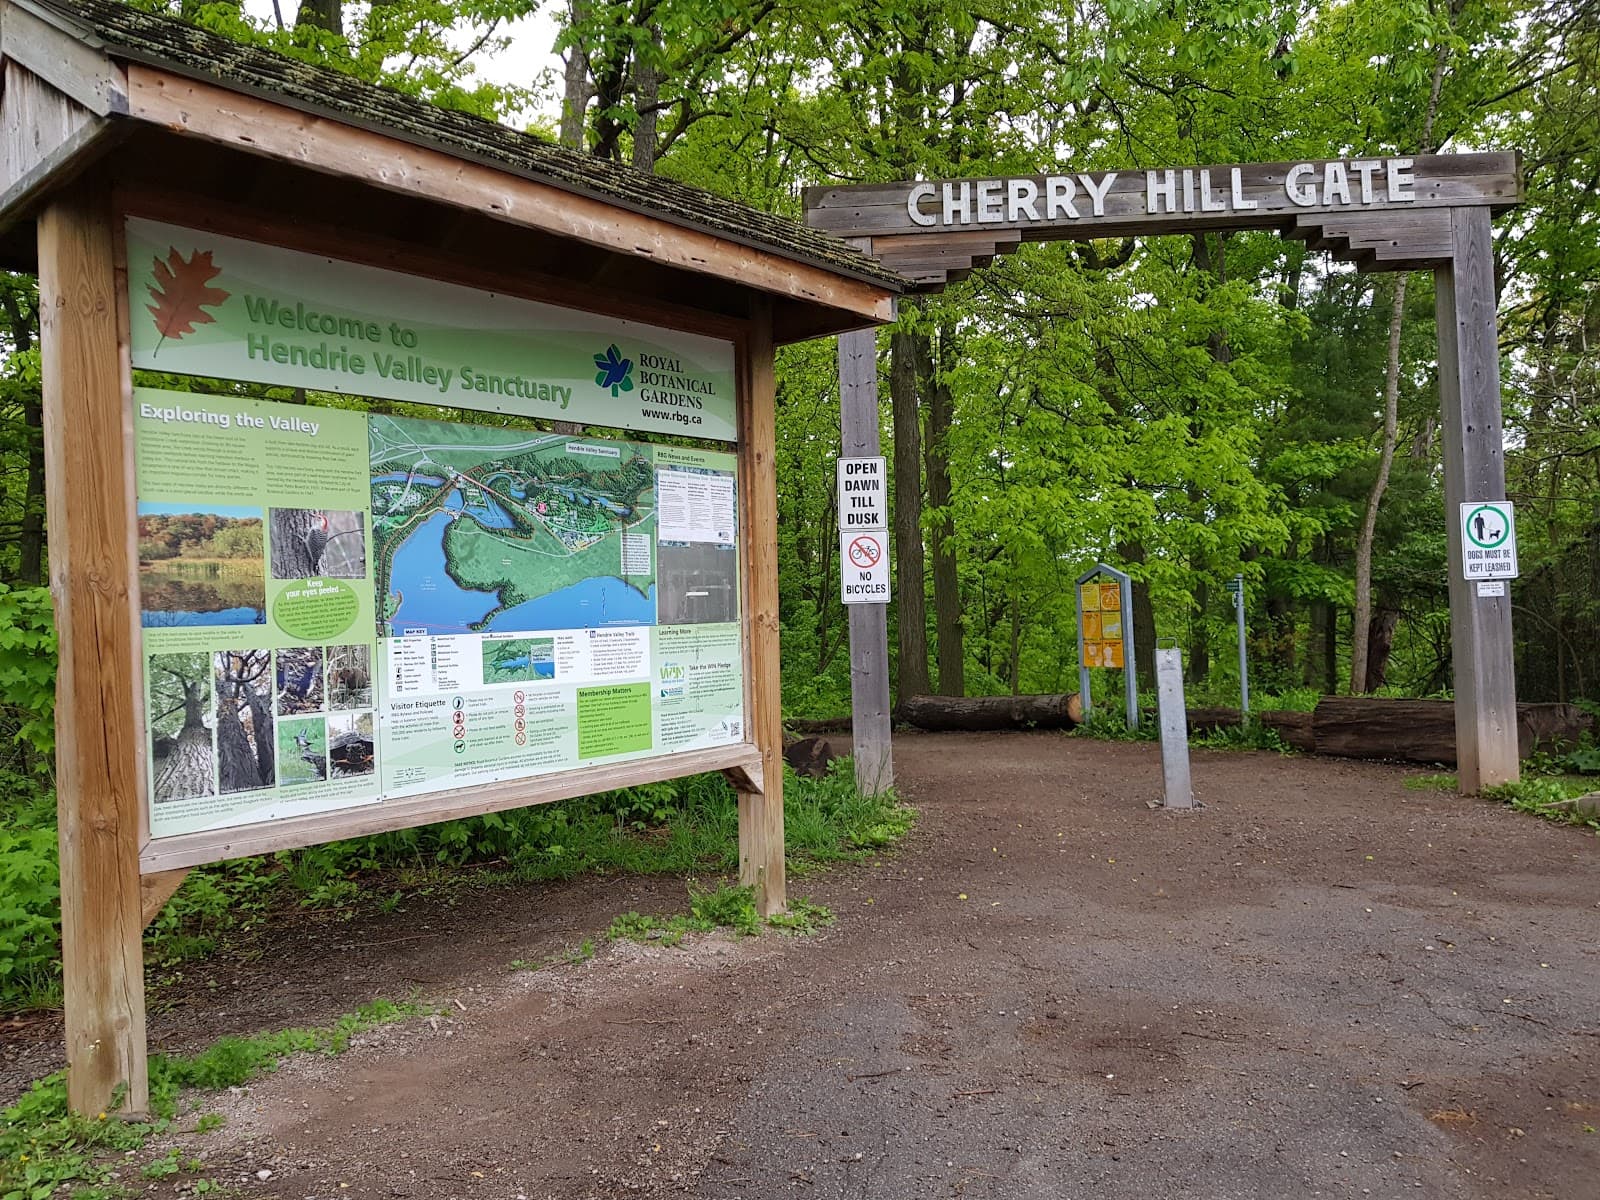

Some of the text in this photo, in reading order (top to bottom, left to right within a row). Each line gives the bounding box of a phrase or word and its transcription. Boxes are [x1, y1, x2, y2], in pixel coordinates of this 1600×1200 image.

[907, 158, 1416, 227] CHERRY HILL GATE
[244, 294, 418, 350] Welcome to
[640, 352, 684, 374] ROYAL
[247, 332, 572, 409] Hendrie Valley Sanctuary
[640, 371, 716, 396] BOTANICAL
[641, 388, 703, 410] GARDENS
[139, 402, 320, 436] Exploring the Valley
[641, 407, 703, 426] www.rbg.ca
[846, 463, 877, 475] OPEN
[845, 479, 879, 491] DAWN
[850, 496, 875, 508] TILL
[847, 512, 879, 525] DUSK
[1467, 549, 1511, 559] DOGS MUST BE
[1469, 562, 1511, 573] KEPT LEASHED
[859, 571, 872, 581] NO
[307, 579, 323, 588] Keep
[846, 583, 886, 594] BICYCLES
[285, 585, 339, 600] your eyes peeled
[579, 689, 611, 698] Membership
[391, 699, 446, 711] Visitor Etiquette
